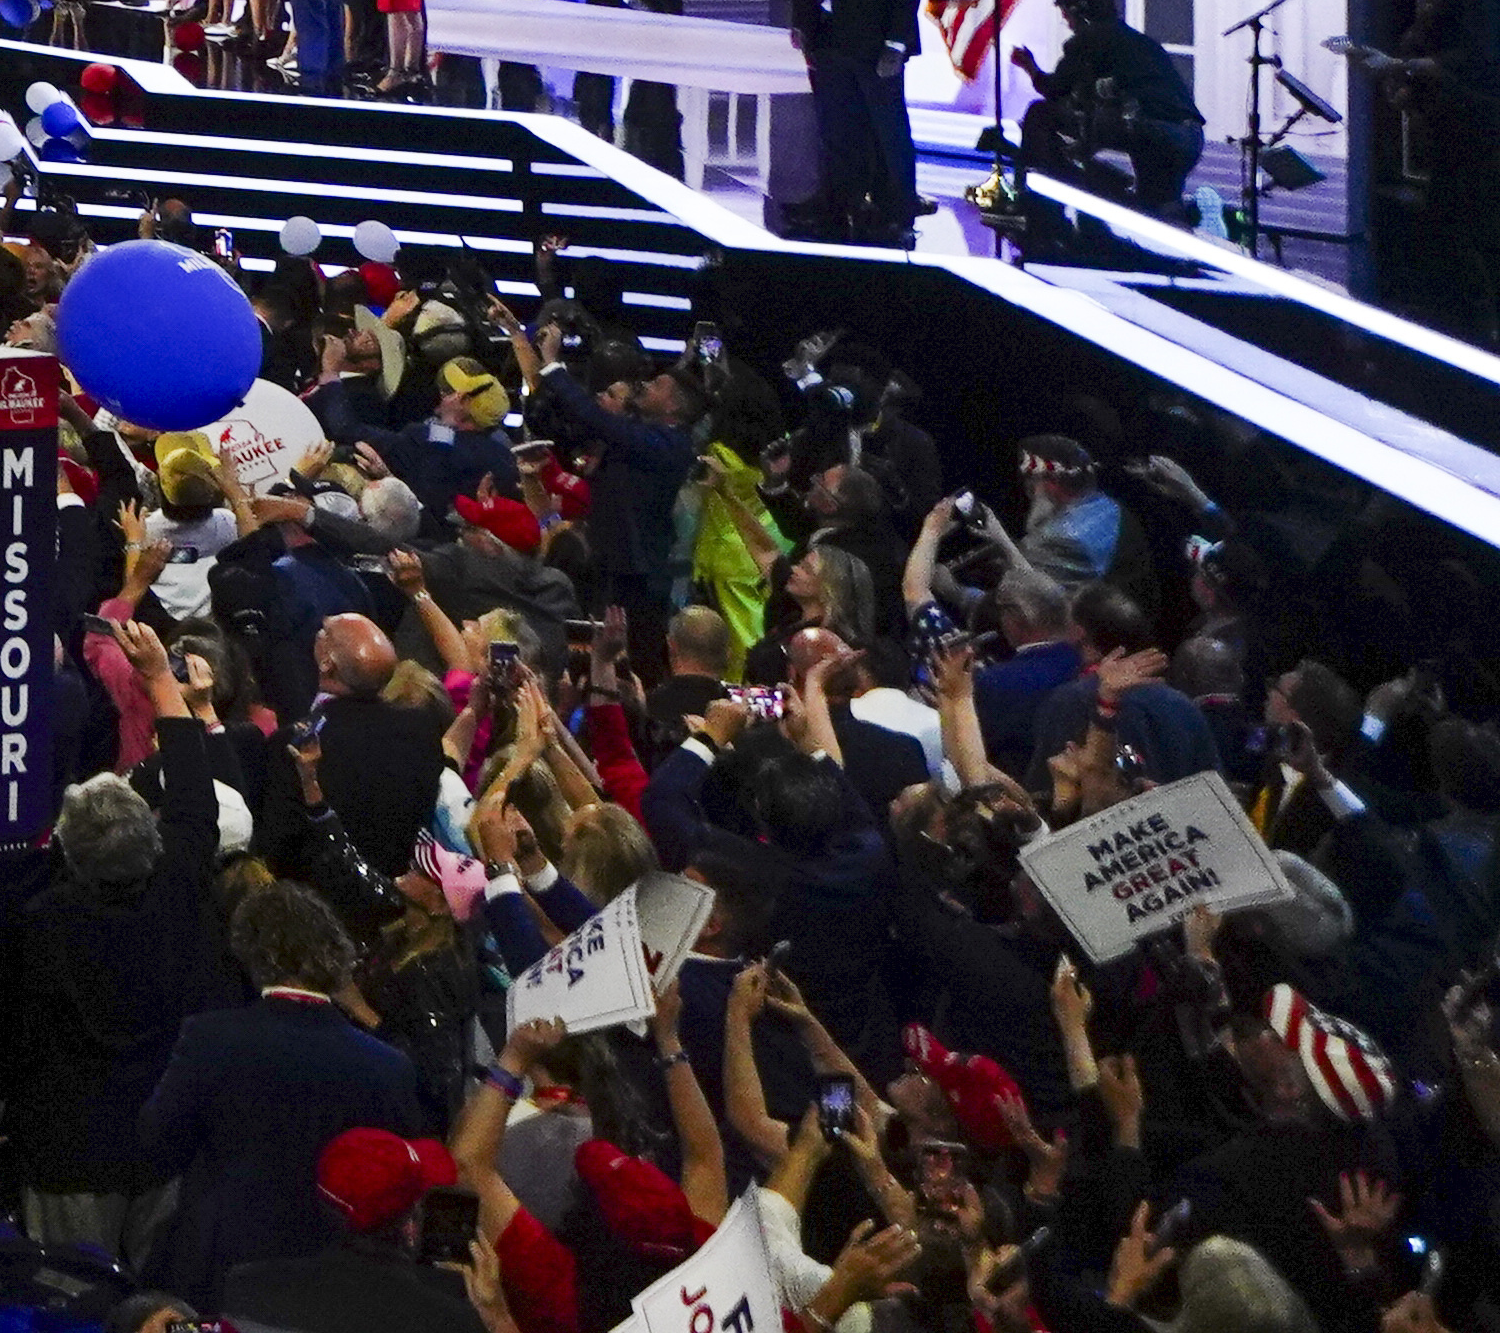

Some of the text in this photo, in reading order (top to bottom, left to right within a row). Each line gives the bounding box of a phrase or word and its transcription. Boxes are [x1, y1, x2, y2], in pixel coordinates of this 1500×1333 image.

[0, 447, 35, 822] MISSOURI
[1083, 824, 1209, 893] AMERICA
[1086, 812, 1168, 861] MAKE
[1111, 845, 1200, 900] GREAT
[1125, 867, 1221, 924] AGAIN!
